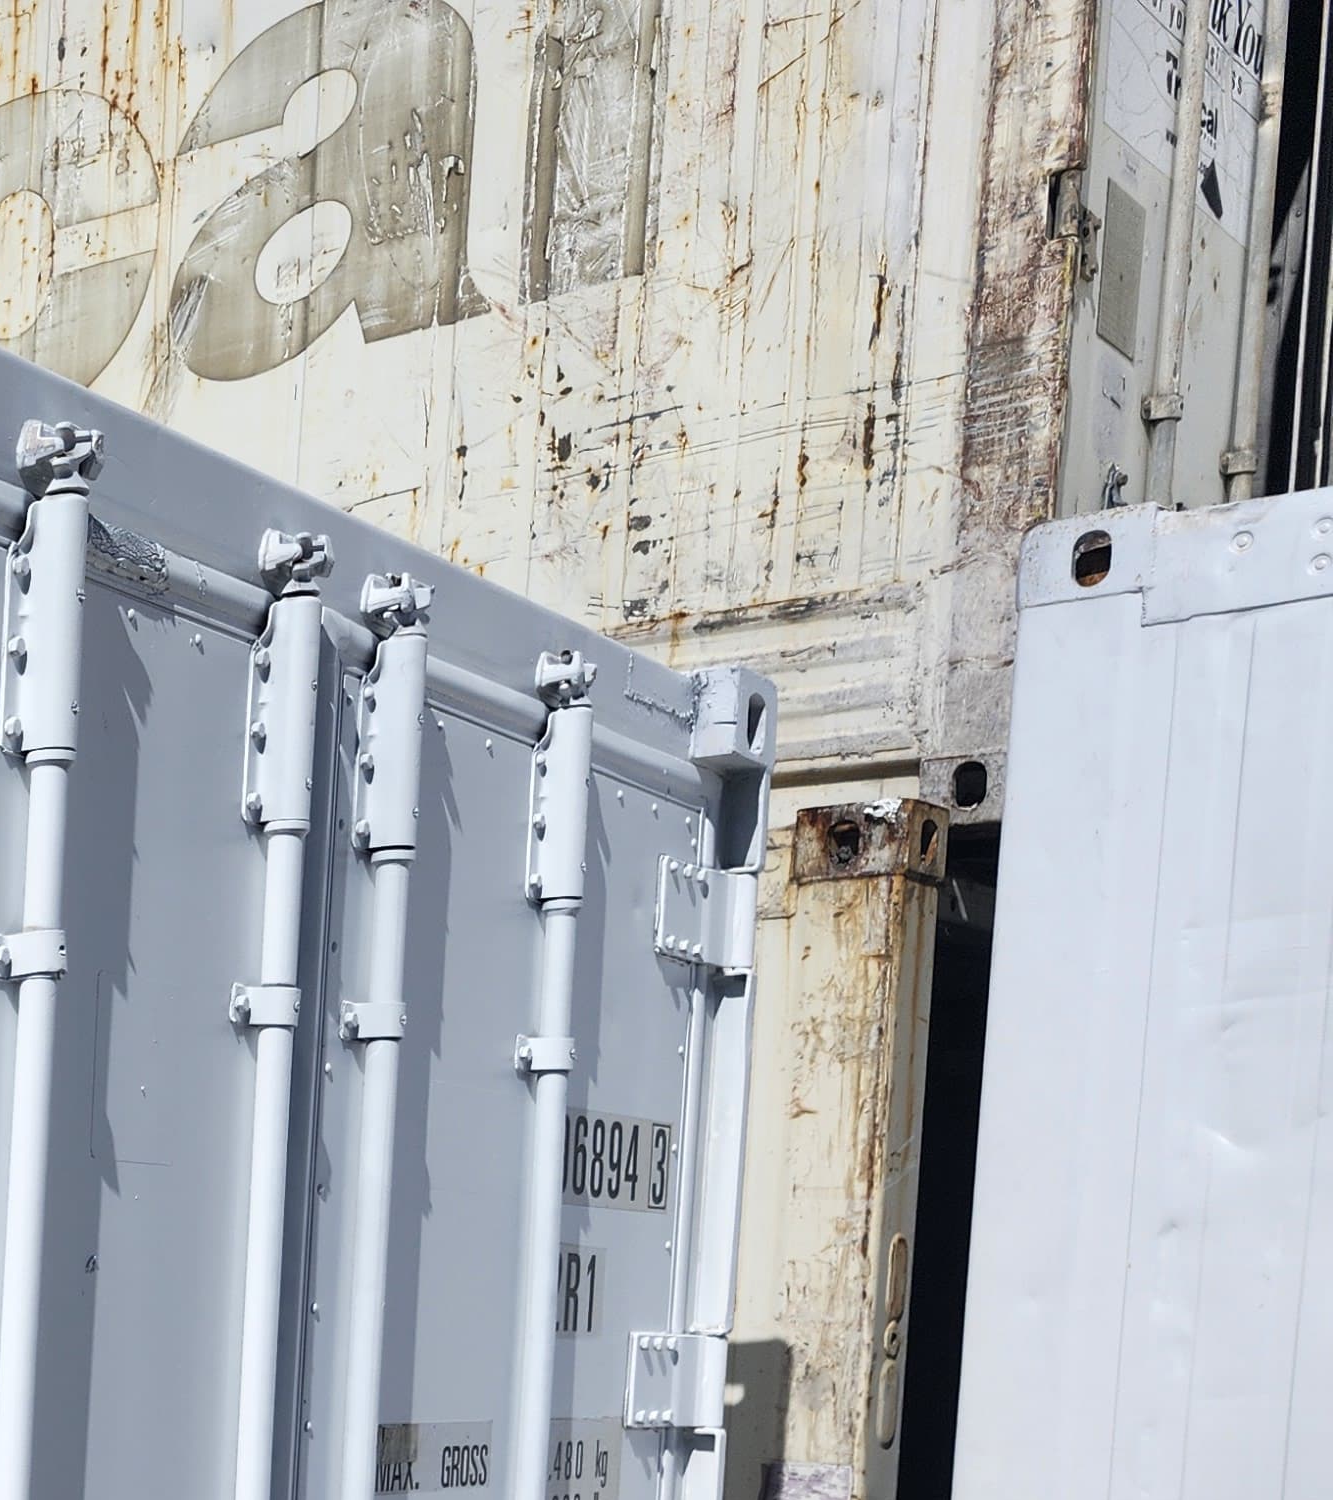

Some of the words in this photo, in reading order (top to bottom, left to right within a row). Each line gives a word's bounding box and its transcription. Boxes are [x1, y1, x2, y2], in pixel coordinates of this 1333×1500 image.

[651, 1128, 667, 1205] 3
[556, 1252, 597, 1333] R1
[441, 1443, 489, 1489] GROSS
[547, 1440, 584, 1481] .480
[595, 1439, 608, 1489] kg
